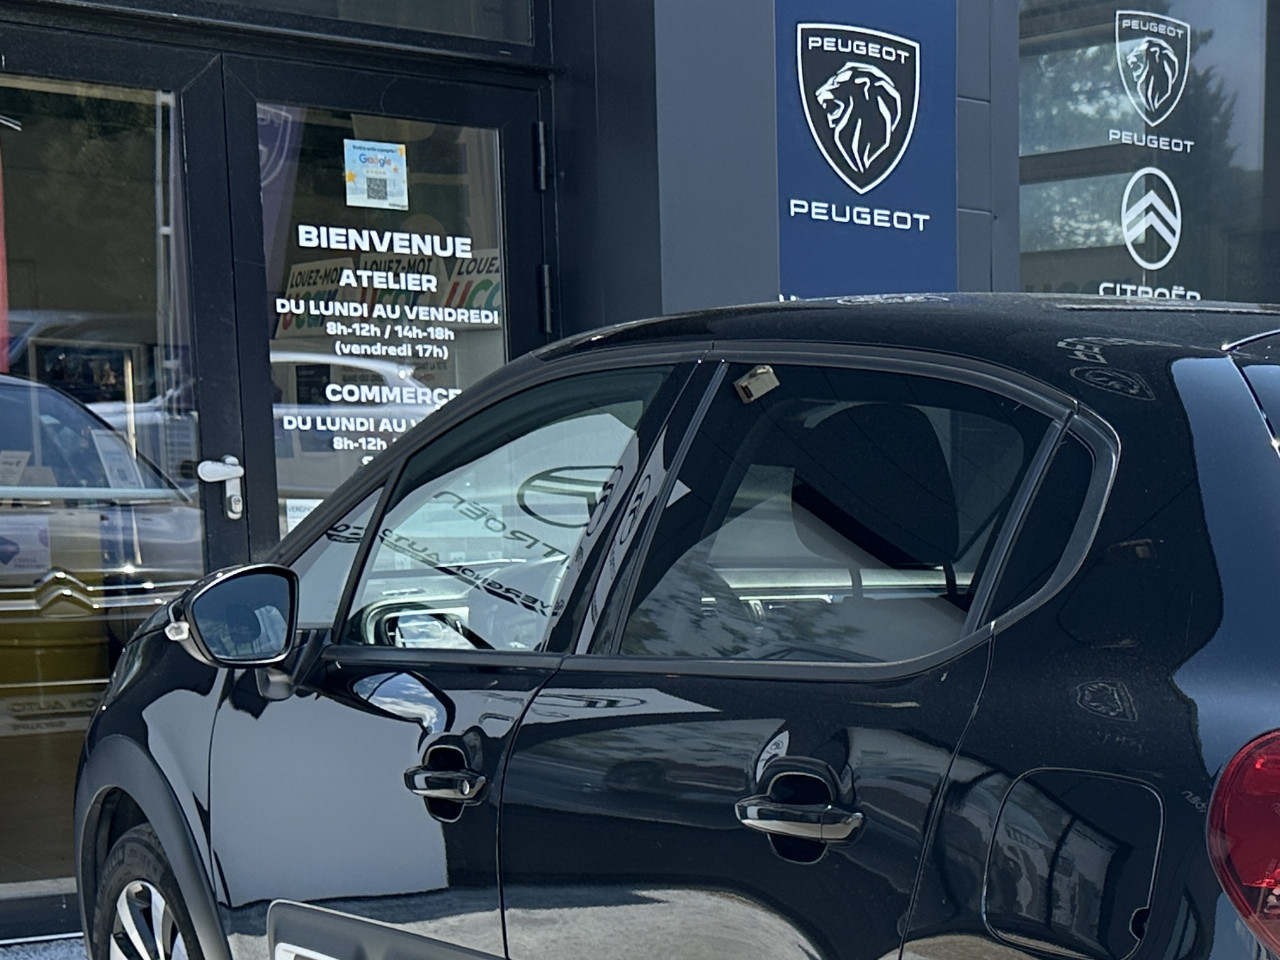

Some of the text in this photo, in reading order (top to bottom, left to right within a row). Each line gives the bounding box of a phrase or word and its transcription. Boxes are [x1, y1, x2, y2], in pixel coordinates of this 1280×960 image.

[1121, 18, 1185, 39] PEUGEOT
[807, 36, 911, 64] PEUGEOT
[1108, 128, 1195, 153] PEUGEOT
[359, 153, 392, 168] Google
[789, 199, 931, 232] PEUGEOT
[297, 224, 473, 259] BIENVENUE
[456, 256, 500, 276] LOUE
[338, 268, 438, 293] ATELIER
[275, 298, 499, 325] DU LUNDI AU VENDREDI
[326, 321, 381, 337] 8h-12h
[394, 324, 455, 341] 14h-18h
[334, 340, 449, 361] (vendredi 17h)
[283, 415, 312, 431] DU
[316, 416, 375, 432] LUNDI
[378, 417, 407, 433] AU
[332, 436, 387, 451] 8h-12h
